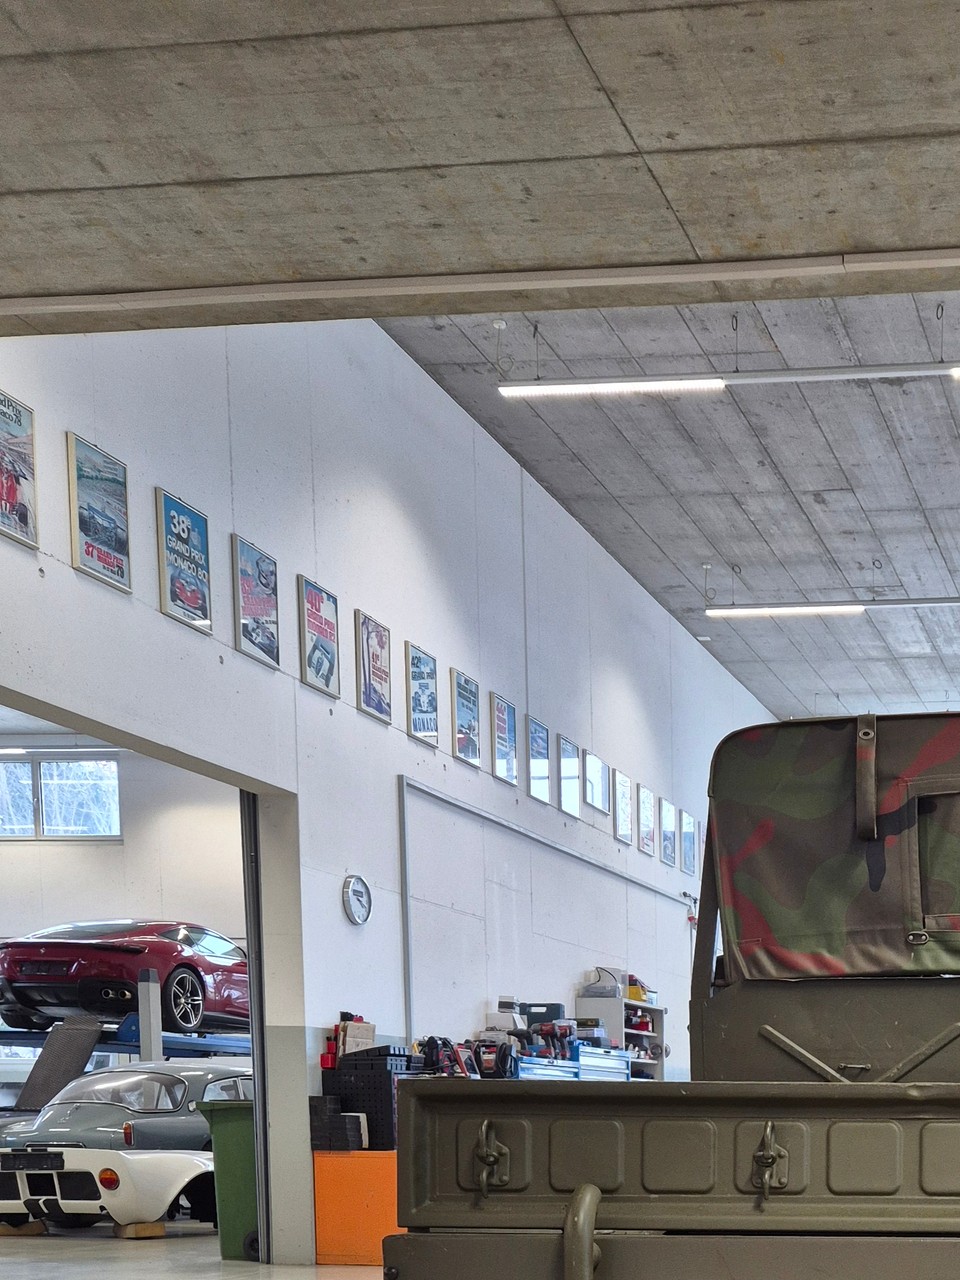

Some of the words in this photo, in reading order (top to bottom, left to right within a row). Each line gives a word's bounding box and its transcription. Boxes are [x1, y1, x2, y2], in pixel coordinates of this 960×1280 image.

[0, 408, 14, 422] aco
[13, 413, 22, 427] 78
[7, 400, 22, 418] Prix
[167, 534, 190, 557] GRAND
[191, 547, 206, 567] PRIX
[166, 550, 196, 576] MONACO
[197, 567, 208, 583] 80
[412, 717, 437, 732] MONACO
